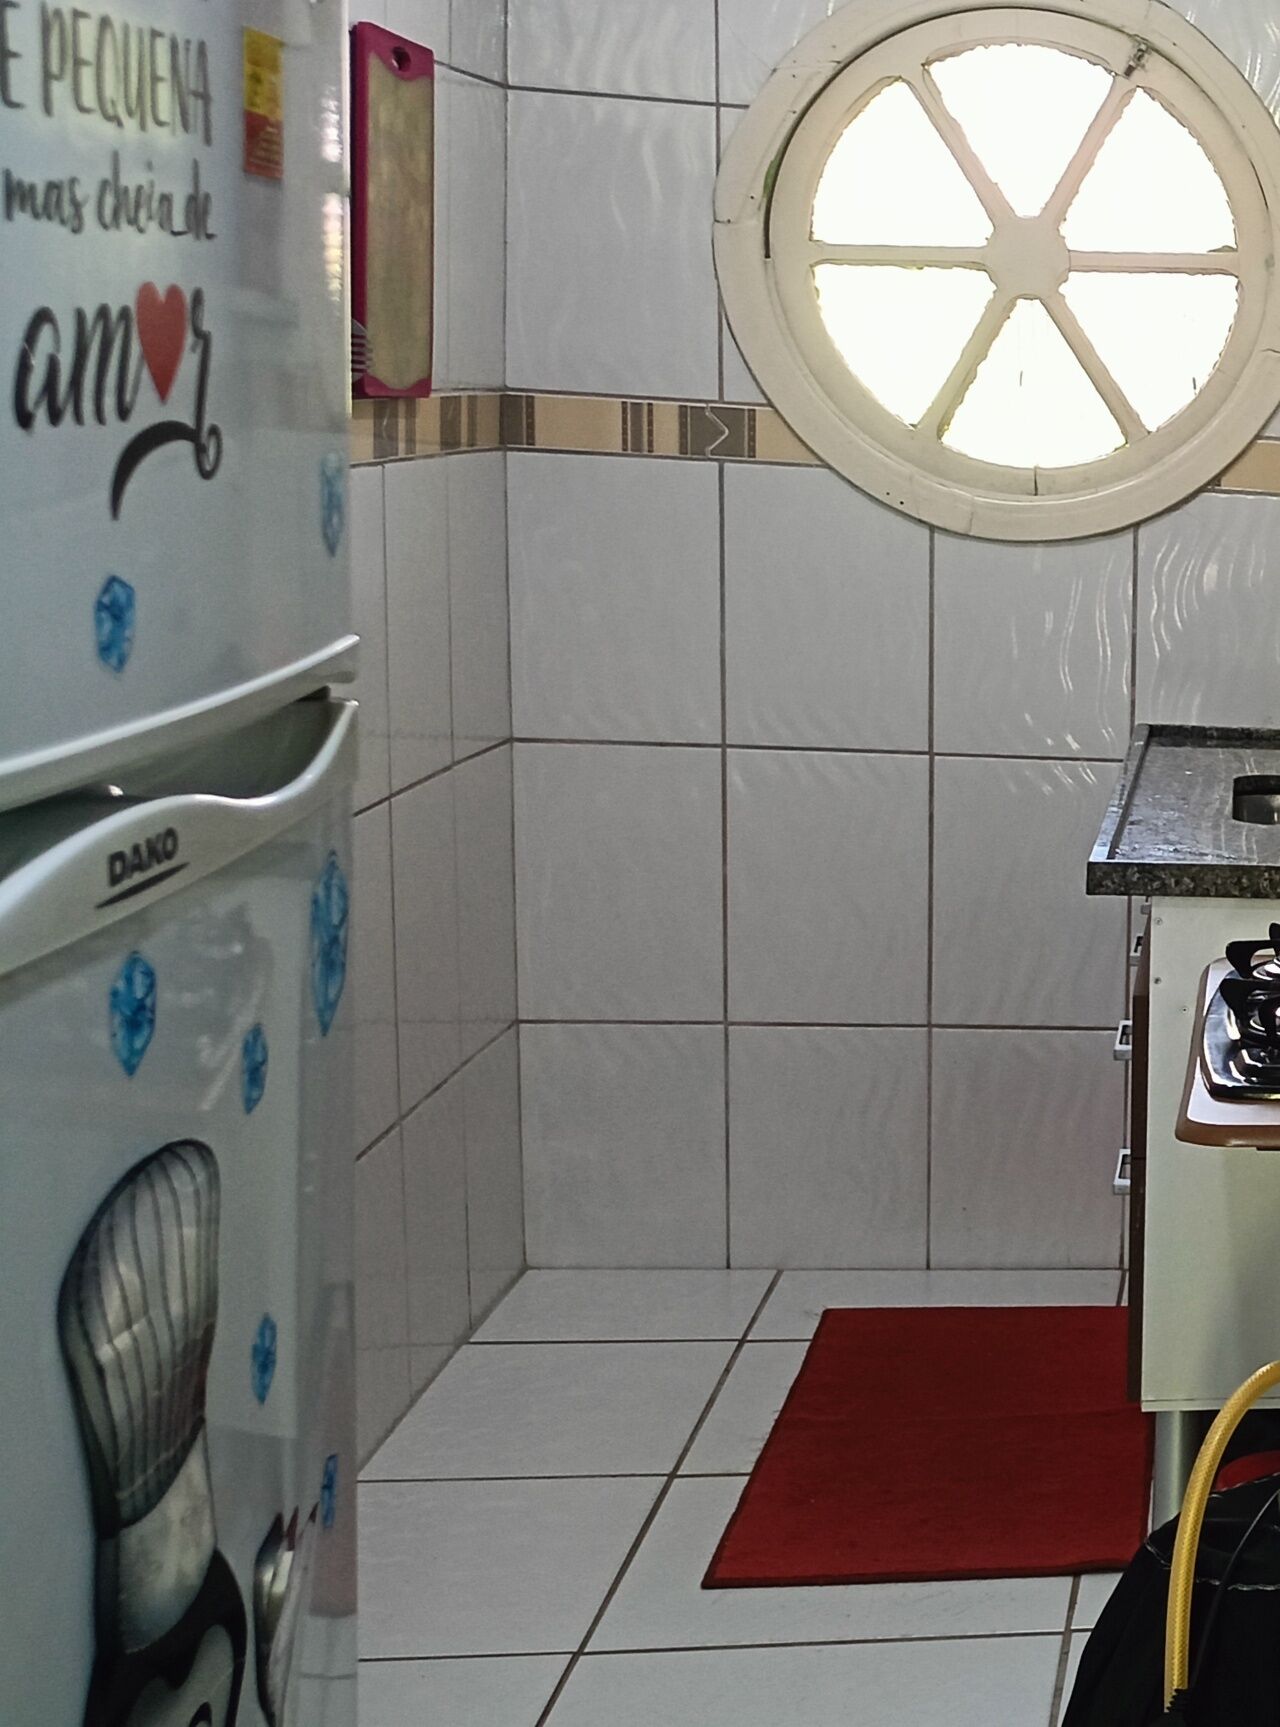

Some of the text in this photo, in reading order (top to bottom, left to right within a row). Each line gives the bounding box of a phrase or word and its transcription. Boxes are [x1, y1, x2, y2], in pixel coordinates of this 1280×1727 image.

[39, 1, 213, 147] PEQUENA
[3, 149, 218, 241] mas cheia de
[107, 827, 179, 887] DAKO
